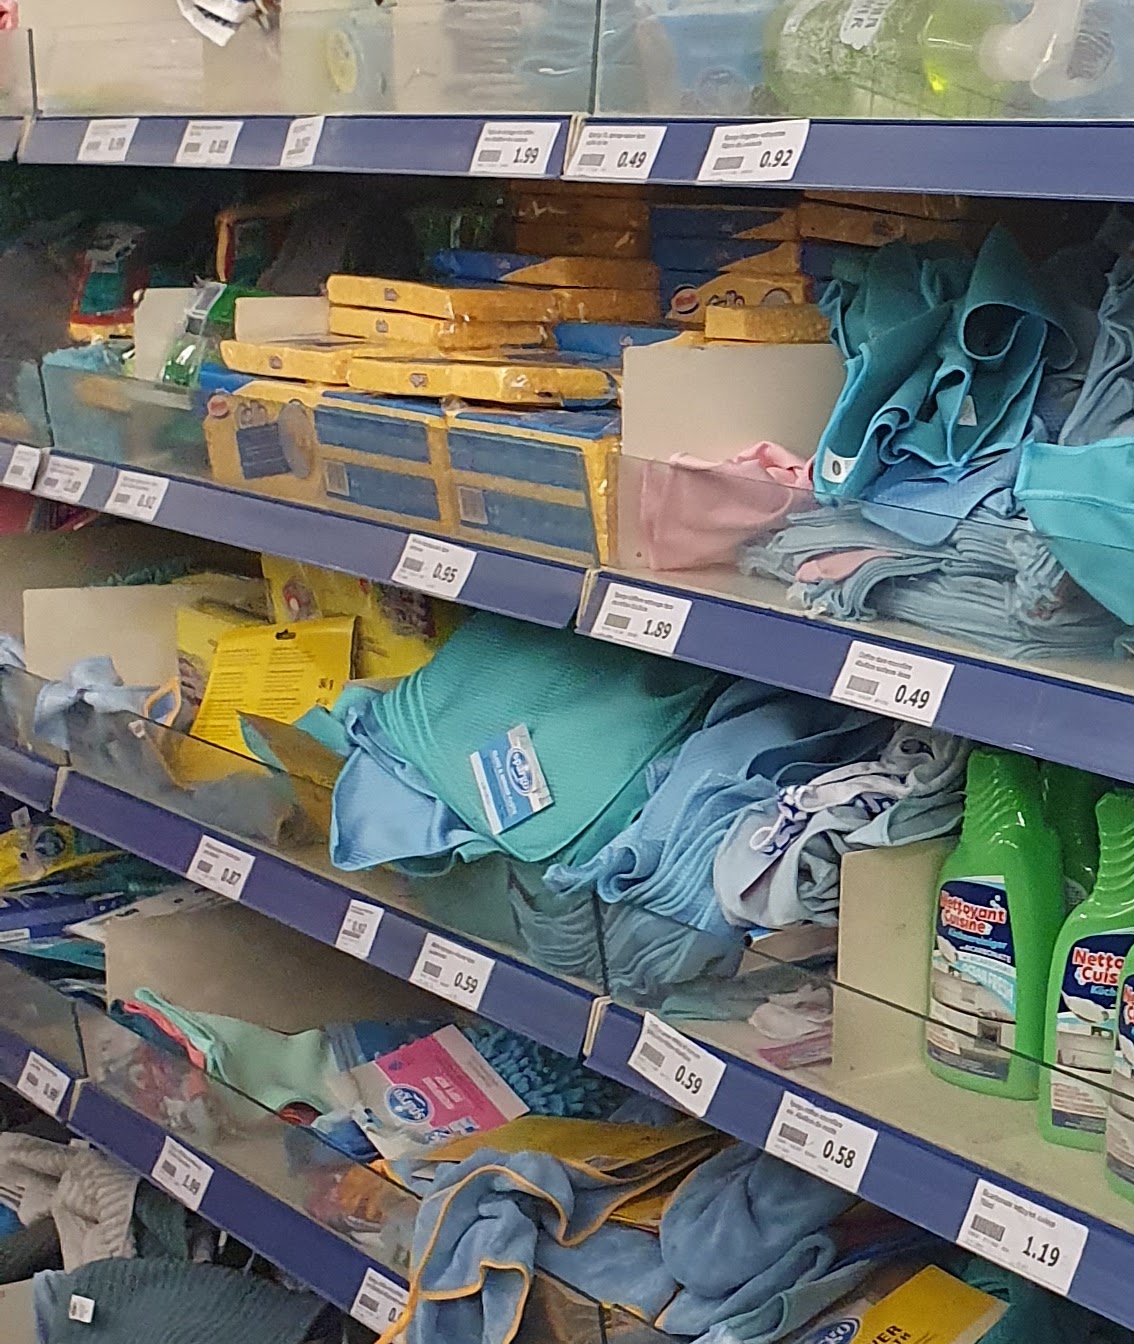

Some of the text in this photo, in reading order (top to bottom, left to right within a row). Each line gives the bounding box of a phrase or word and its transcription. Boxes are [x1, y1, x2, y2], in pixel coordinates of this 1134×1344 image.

[513, 147, 539, 164] 1.99
[617, 151, 647, 169] 0.49
[759, 149, 793, 169] 0.92
[431, 562, 459, 586] 0.95
[643, 619, 672, 640] 1.89
[894, 685, 930, 710] 0.49
[940, 890, 1005, 923] Nettoyant
[944, 912, 987, 934] Cuisine
[455, 972, 478, 993] 0.59
[674, 1064, 703, 1096] 0.59
[823, 1138, 856, 1170] 0.58
[1022, 1235, 1061, 1267] 1.19
